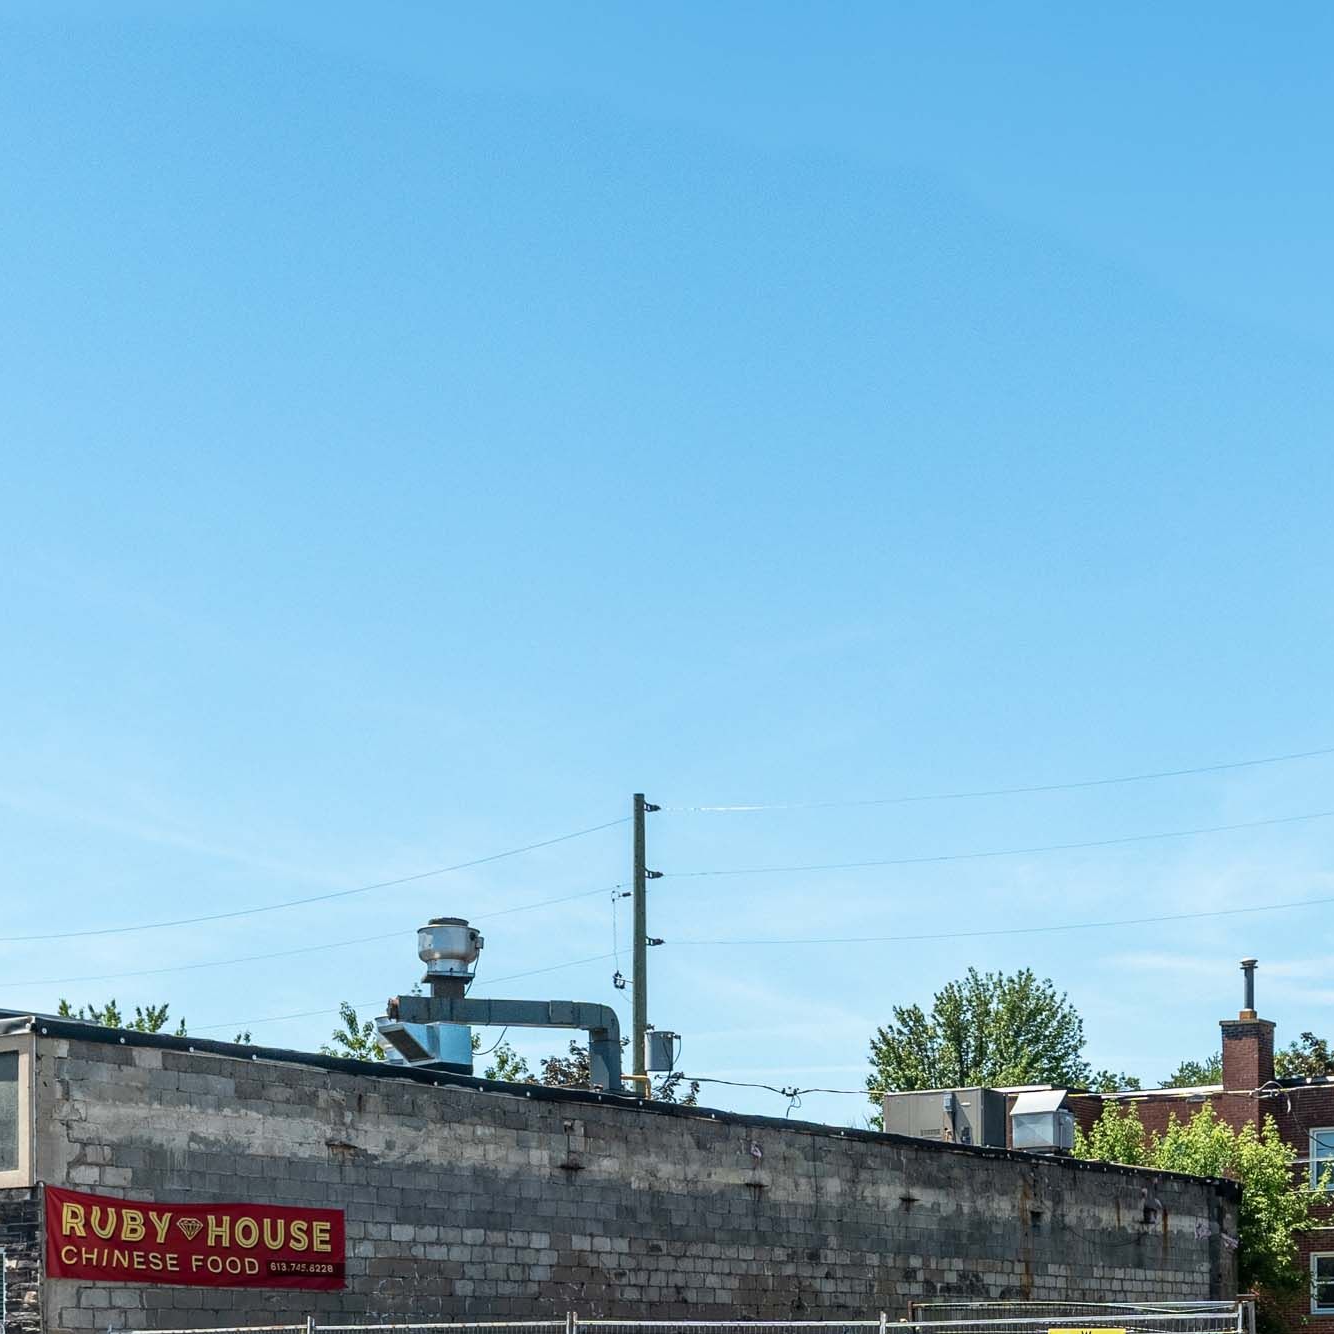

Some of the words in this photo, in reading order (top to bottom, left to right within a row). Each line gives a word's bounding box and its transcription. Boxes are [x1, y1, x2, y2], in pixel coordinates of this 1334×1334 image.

[62, 1202, 173, 1243] RUBY
[207, 1215, 331, 1252] HOUSE
[61, 1246, 180, 1271] CHINESE
[191, 1254, 259, 1274] FOOD
[270, 1262, 334, 1274] 613.745.8228
